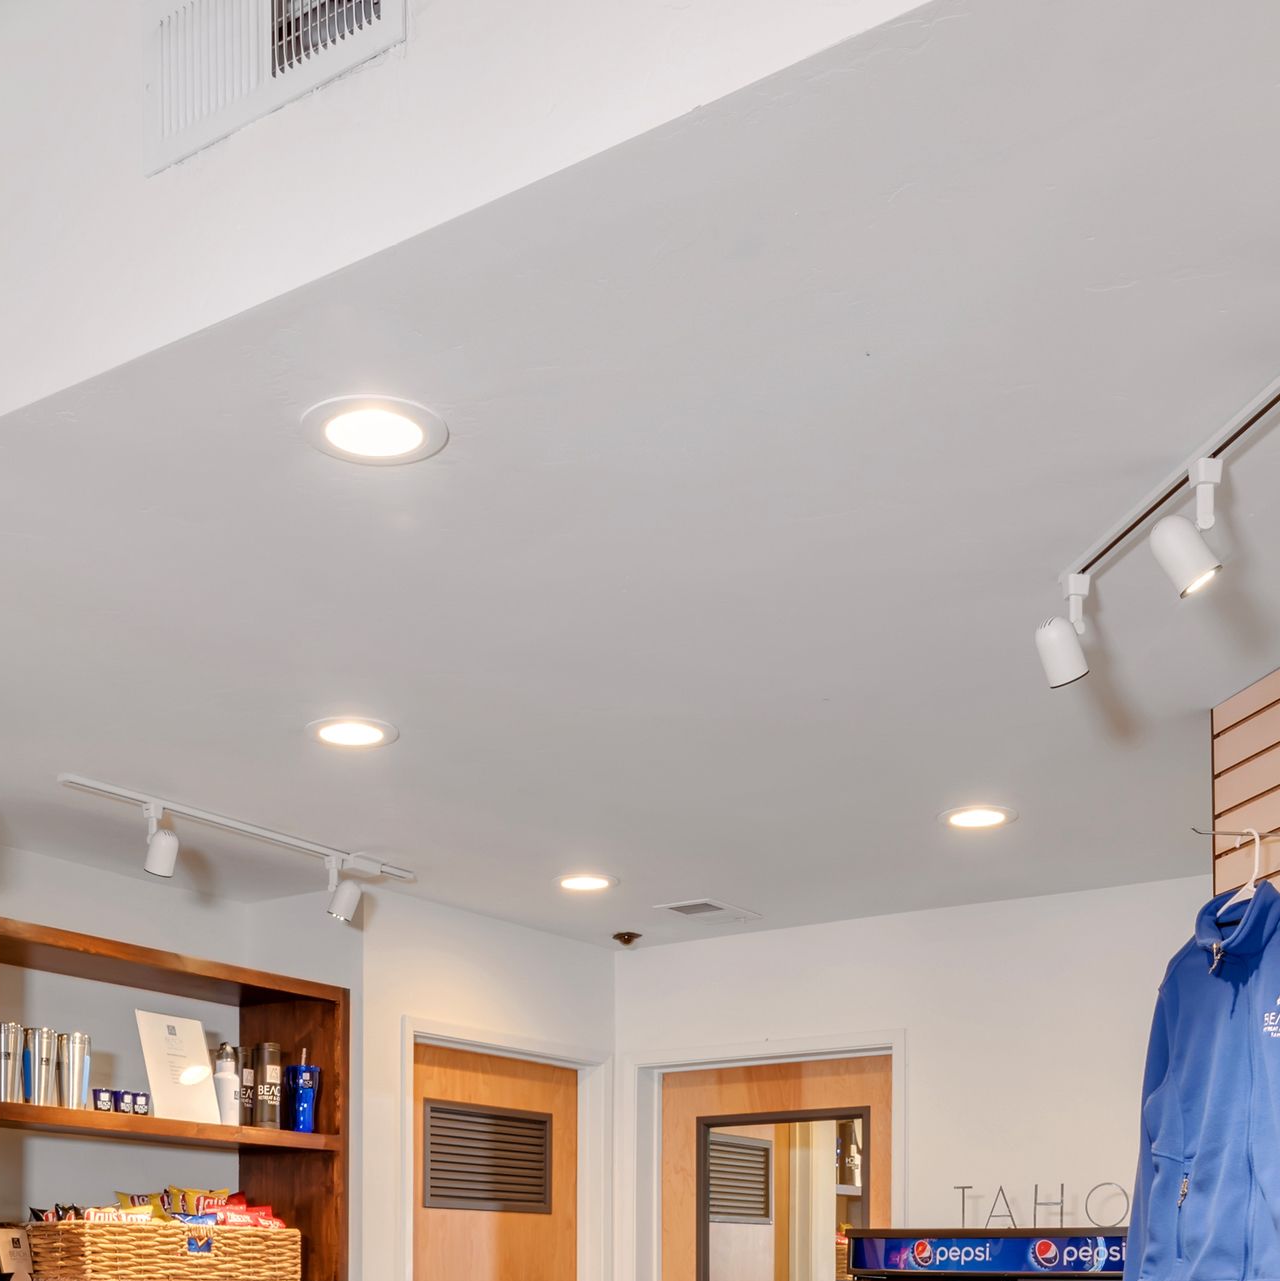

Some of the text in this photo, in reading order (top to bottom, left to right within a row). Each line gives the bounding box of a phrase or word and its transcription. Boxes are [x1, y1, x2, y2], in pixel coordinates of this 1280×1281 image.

[258, 1085, 280, 1095] BEAC
[953, 1182, 1129, 1228] TAHO
[936, 1243, 990, 1265] pepsi
[1063, 1242, 1126, 1266] pepsi
